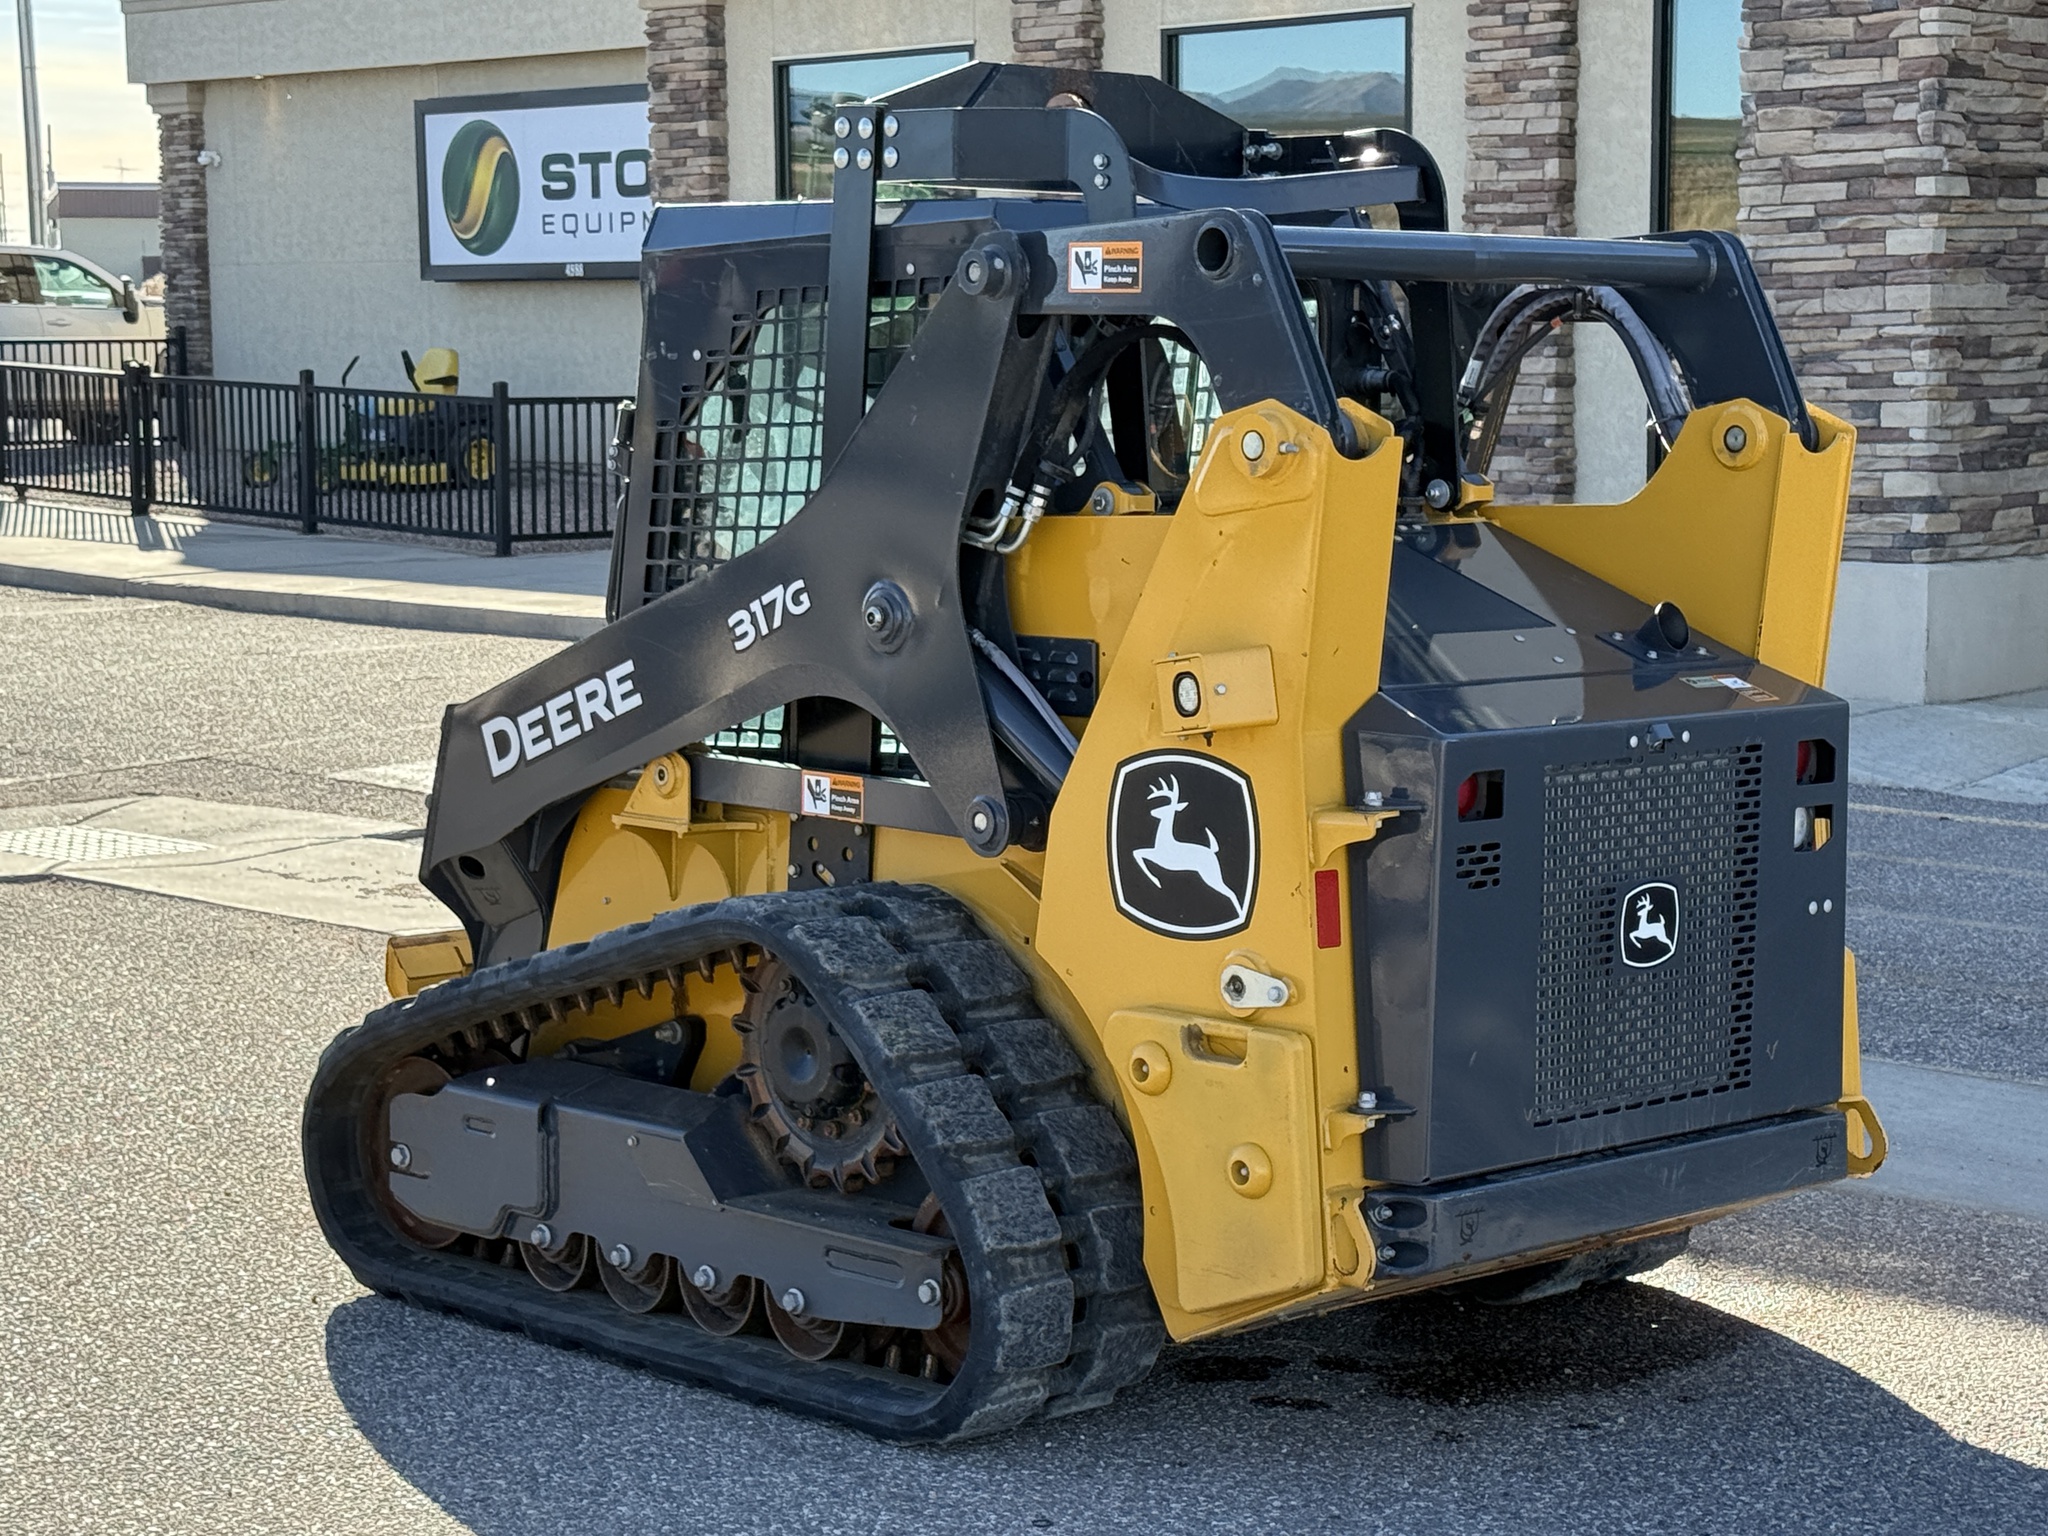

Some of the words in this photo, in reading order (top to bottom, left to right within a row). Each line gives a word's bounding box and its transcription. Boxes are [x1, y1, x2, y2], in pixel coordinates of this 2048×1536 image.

[541, 149, 652, 200] STO
[1103, 275, 1117, 284] Keep
[1118, 275, 1133, 284] Away
[1104, 264, 1121, 273] Pinch
[1122, 264, 1137, 273] Area
[727, 579, 812, 651] 317G
[481, 659, 643, 778] DEERE
